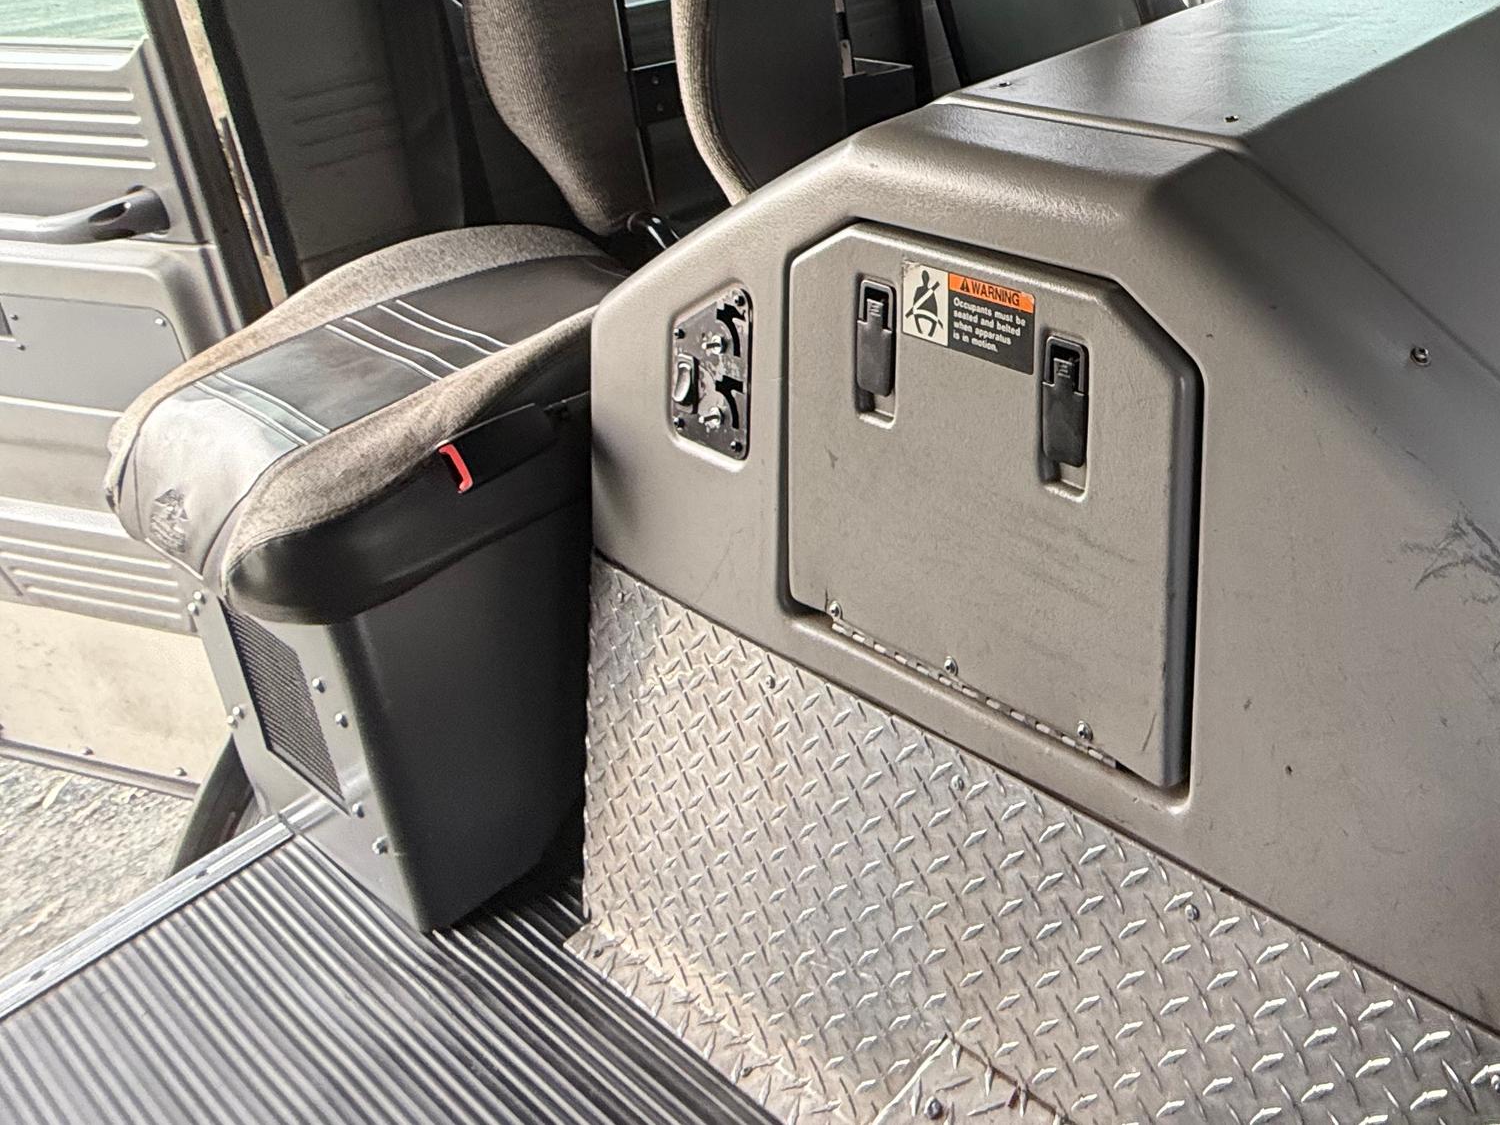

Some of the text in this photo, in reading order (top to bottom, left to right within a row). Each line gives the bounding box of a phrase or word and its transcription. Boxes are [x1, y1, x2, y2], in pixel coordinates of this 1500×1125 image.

[971, 280, 1020, 306] WARNING
[953, 297, 1026, 327] Occupants must be
[953, 310, 1021, 336] seated and belted
[953, 321, 1012, 346] when apparatus
[953, 331, 998, 352] is in motion.
